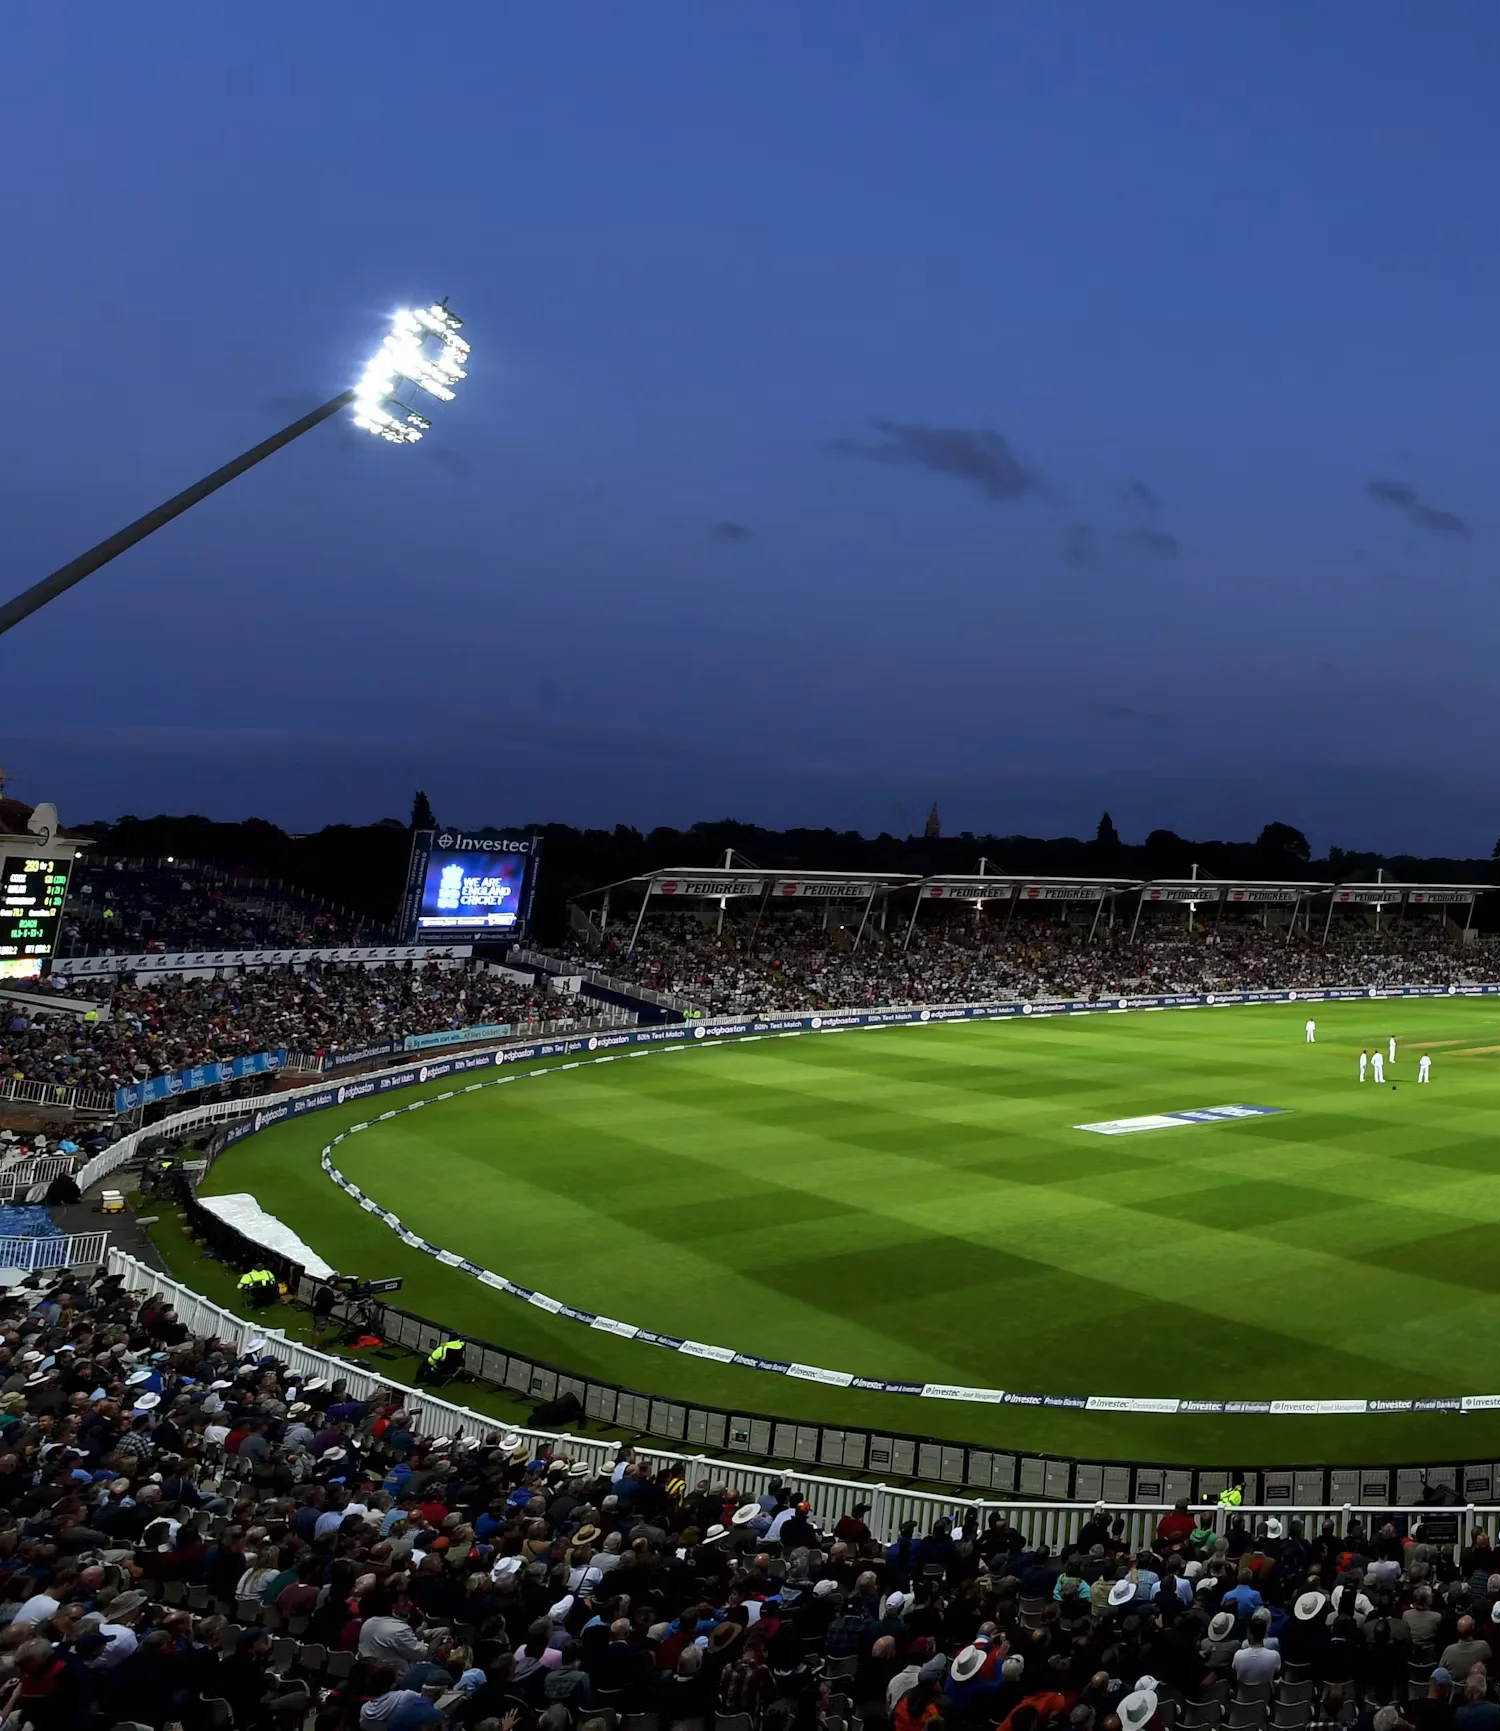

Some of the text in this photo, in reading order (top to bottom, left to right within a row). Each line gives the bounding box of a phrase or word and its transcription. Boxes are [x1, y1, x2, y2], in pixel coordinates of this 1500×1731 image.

[455, 834, 530, 852] Investec
[464, 877, 502, 887] WE ARE
[462, 886, 511, 896] ENGLAND
[685, 883, 746, 894] PEDIGREE
[803, 886, 860, 896] PEDIGREE
[950, 888, 998, 897] PEDIGREE
[1045, 889, 1092, 898] PEDIGREE
[460, 896, 504, 905] CRICKET
[931, 1010, 965, 1019] edgbaston
[823, 1016, 859, 1026] edgbaston
[706, 1026, 746, 1036] edgbaston
[597, 1036, 629, 1047] edgbaston
[504, 1048, 534, 1062] edgbaston
[427, 1064, 450, 1079] edgbaston
[345, 1083, 374, 1100] edgbaston
[261, 1106, 288, 1125] edgbaston
[858, 1378, 885, 1390] Investec
[931, 1386, 960, 1397] Investec
[1012, 1394, 1042, 1405] Investec
[1097, 1398, 1130, 1408] Investec
[1188, 1400, 1222, 1410] Investec
[1281, 1402, 1316, 1411] Investec
[1376, 1400, 1412, 1410] Investec
[1415, 1402, 1436, 1410] Private
